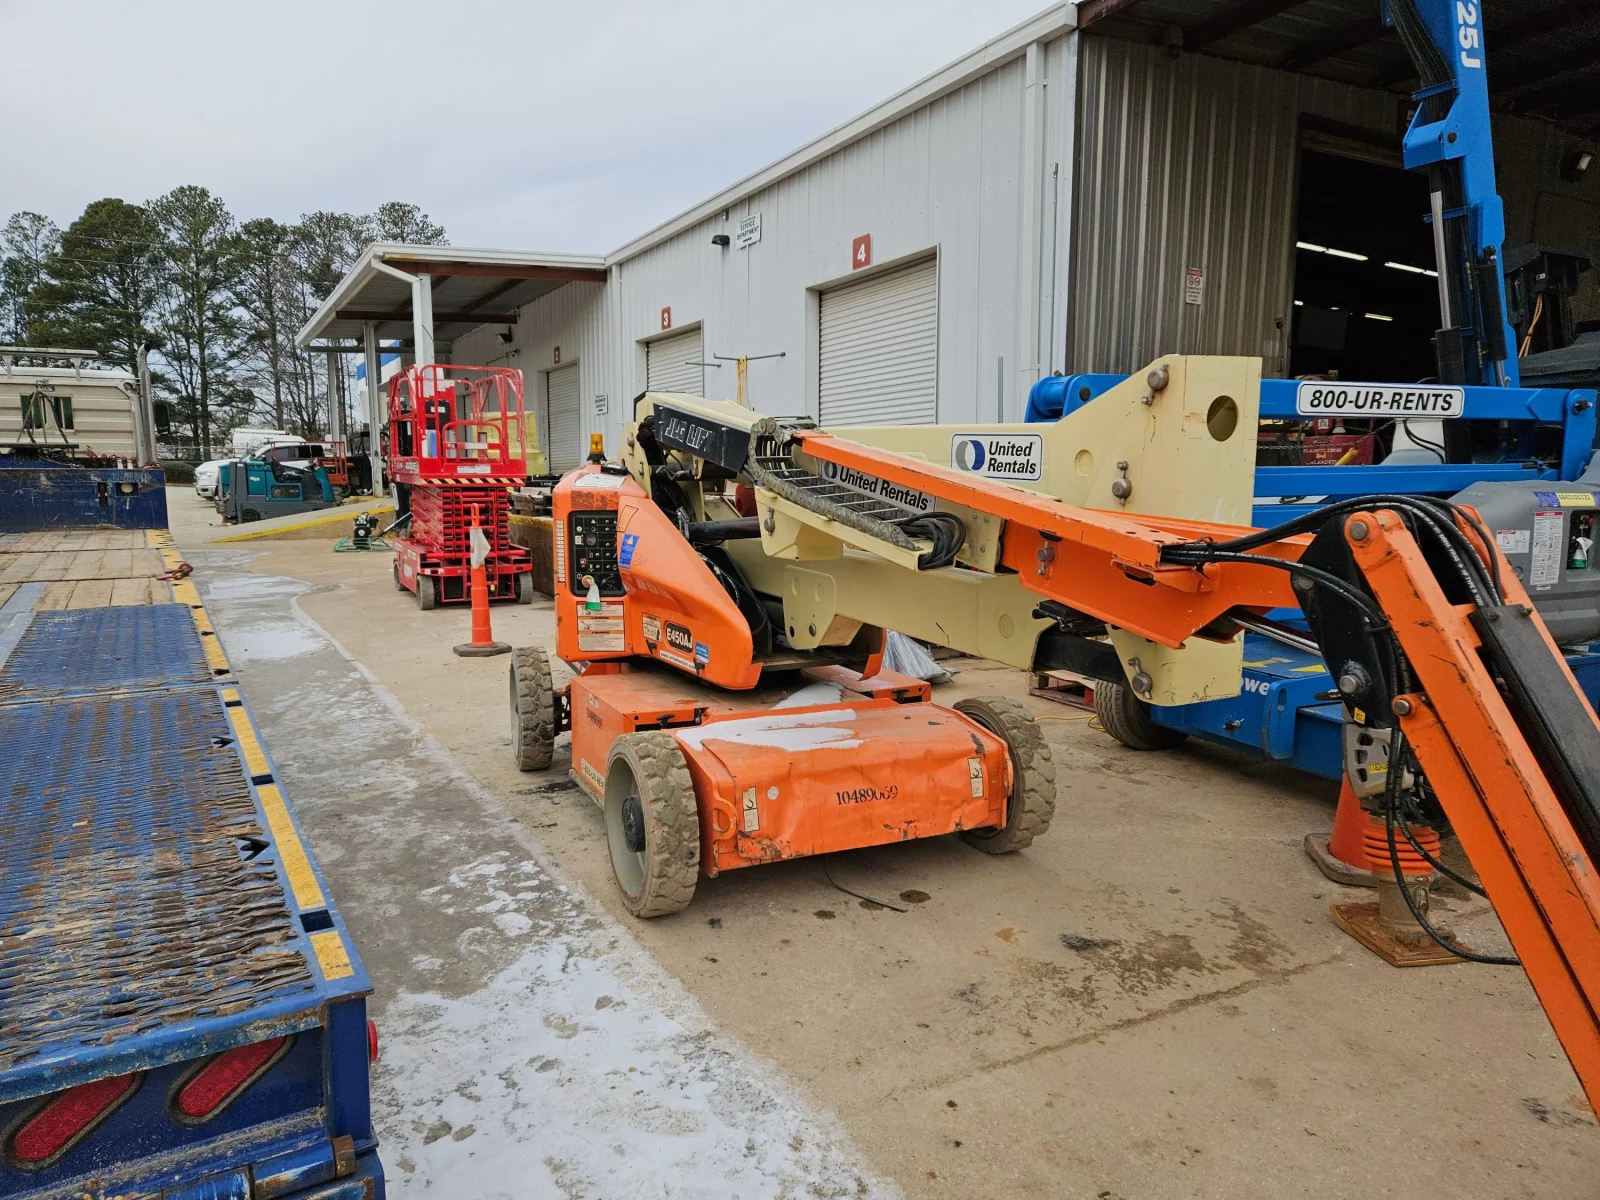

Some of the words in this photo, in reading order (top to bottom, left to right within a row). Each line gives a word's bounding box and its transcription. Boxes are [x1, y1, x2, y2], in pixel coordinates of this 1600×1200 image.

[1457, 0, 1481, 68] 25J
[857, 243, 866, 262] 4
[663, 312, 669, 326] 3
[1310, 389, 1454, 412] 800-UR-RENTS
[988, 440, 1033, 457] United
[987, 457, 1037, 474] Rentals
[839, 466, 879, 494] United
[879, 479, 929, 511] Rentals
[666, 627, 693, 649] E450AJ
[1240, 677, 1270, 695] we
